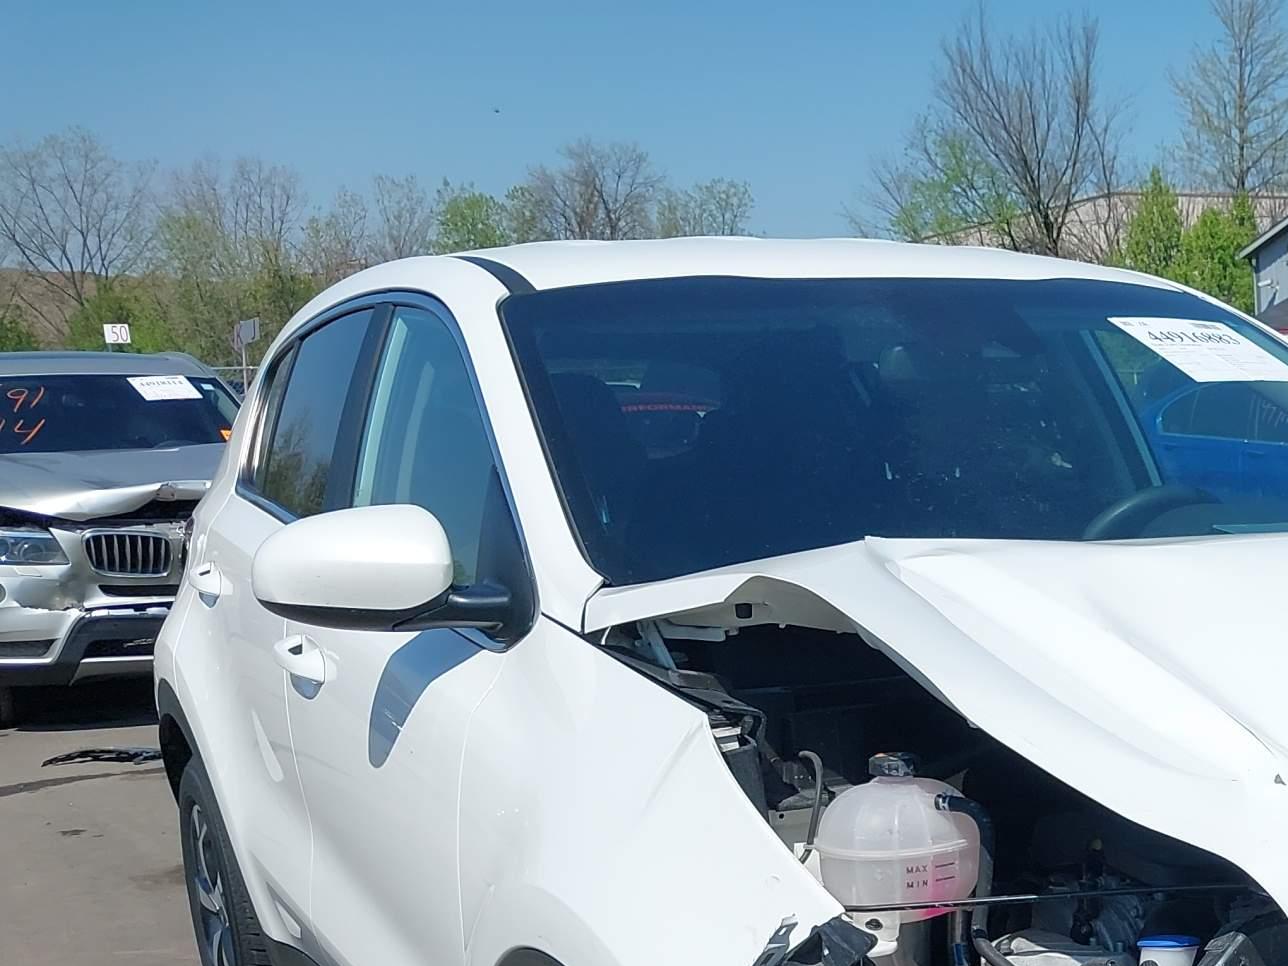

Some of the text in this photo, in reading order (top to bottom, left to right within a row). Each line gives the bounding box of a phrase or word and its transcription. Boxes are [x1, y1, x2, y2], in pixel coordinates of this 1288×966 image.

[111, 326, 128, 342] 50
[1147, 331, 1241, 345] 44916883
[906, 865, 928, 874] MAX
[906, 880, 928, 889] MIN
